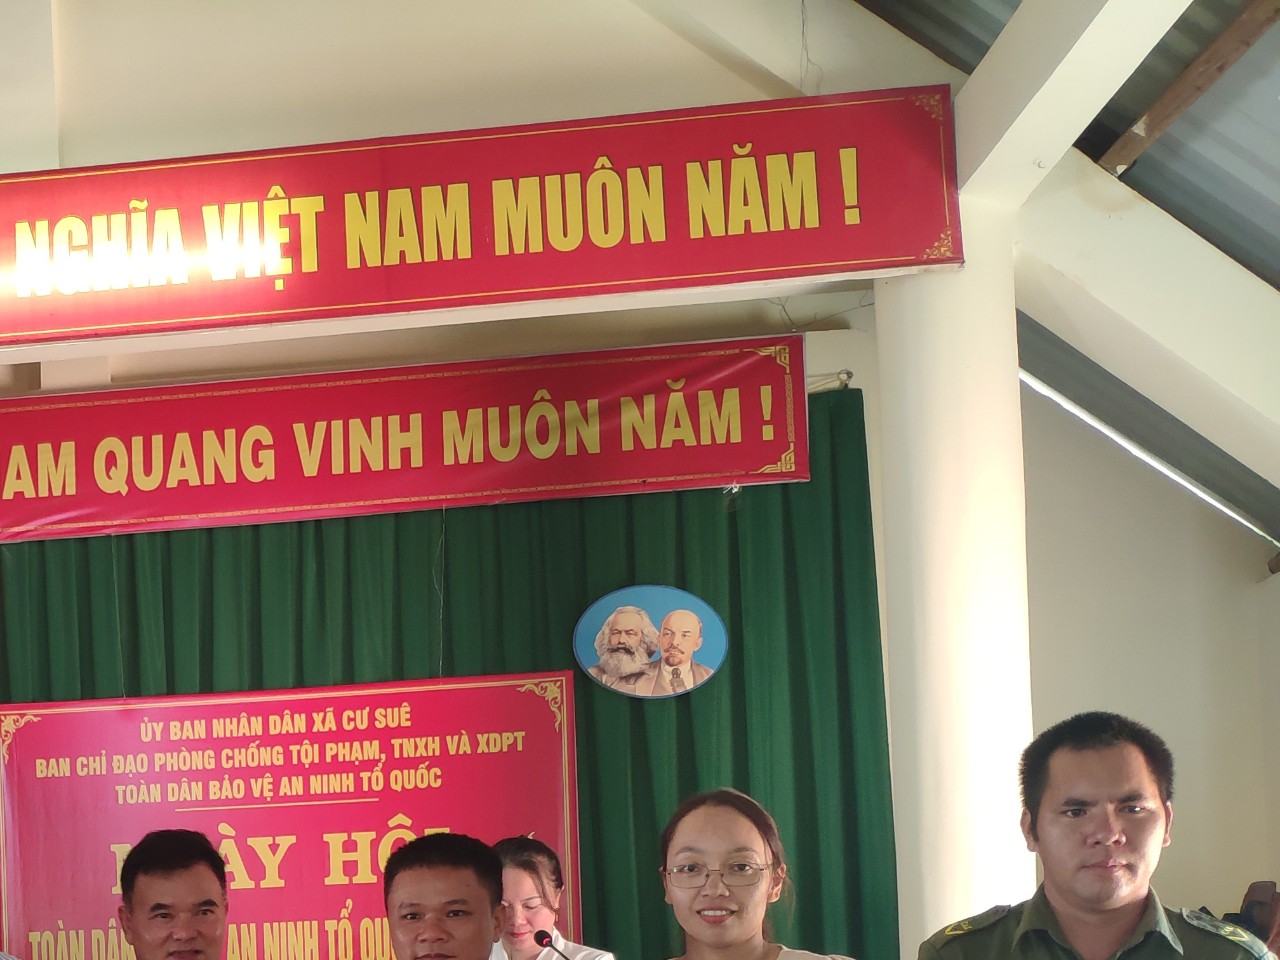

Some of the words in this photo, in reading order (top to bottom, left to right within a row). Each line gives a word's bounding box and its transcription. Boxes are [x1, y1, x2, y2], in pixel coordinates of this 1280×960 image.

[15, 199, 190, 299] NGHĨA
[202, 185, 325, 291] VIỆT
[344, 182, 472, 270] NAM
[492, 156, 666, 257] MUÔN
[686, 142, 819, 240] NĂM
[838, 147, 862, 226] !
[93, 425, 276, 497] QUANG
[292, 412, 423, 477] VINH
[441, 388, 600, 466] MUÔN
[620, 378, 742, 451] NĂM
[759, 384, 775, 441] !
[140, 716, 164, 742] ỦY
[169, 719, 206, 740] BAN
[212, 712, 263, 738] NHÂN
[268, 710, 306, 735] DÂN
[312, 707, 337, 732] XÃ
[342, 706, 370, 731] CƯ
[374, 702, 411, 729] SUÊ
[35, 757, 71, 778] BAN
[75, 750, 107, 776] CHỈ
[112, 753, 148, 778] ĐẠO
[154, 747, 216, 772] PHÒNG
[221, 740, 284, 769] CHỐNG
[289, 739, 319, 769] TỘI
[325, 739, 387, 765] PHẠM,
[391, 736, 440, 758] TNXH
[446, 729, 471, 755] VÀ
[476, 731, 526, 754] XDPT
[115, 779, 161, 805] TOÀN
[167, 777, 203, 802] DÂN
[209, 774, 245, 800] BẢO
[250, 772, 274, 801] VỆ
[279, 775, 304, 797] AN
[309, 772, 355, 795] NINH
[359, 761, 384, 792] TỔ
[389, 761, 442, 793] QUỐC
